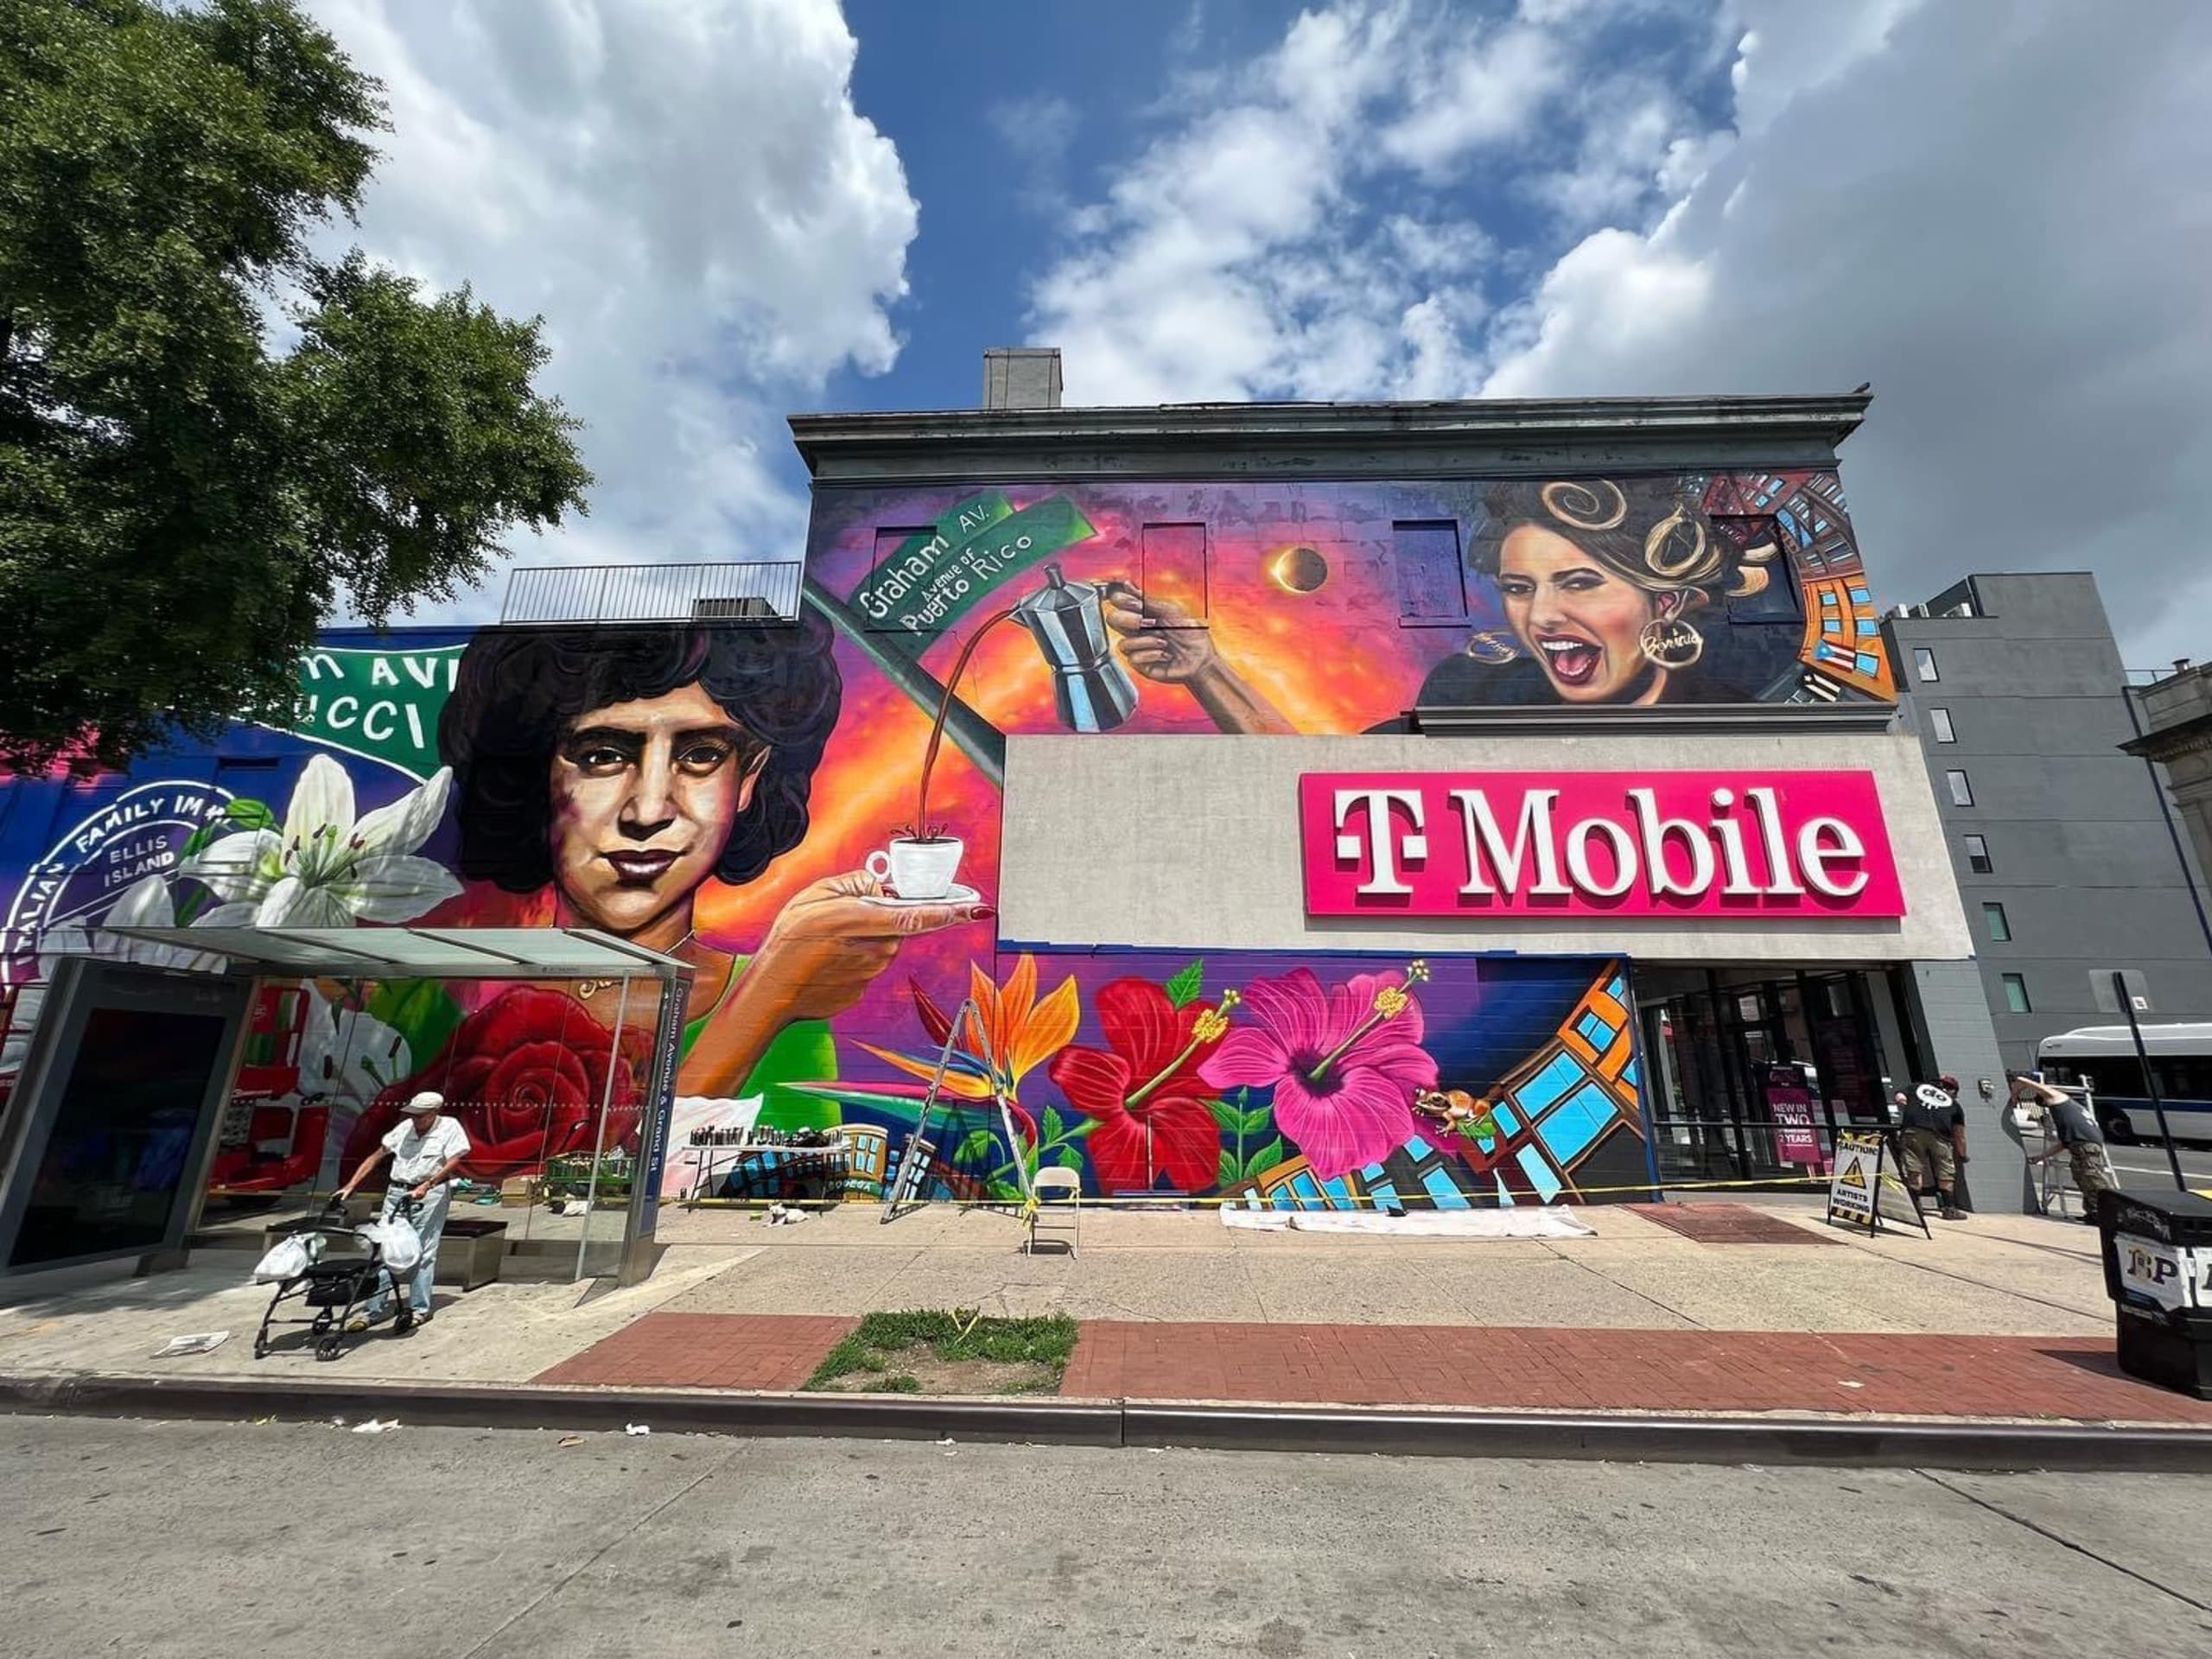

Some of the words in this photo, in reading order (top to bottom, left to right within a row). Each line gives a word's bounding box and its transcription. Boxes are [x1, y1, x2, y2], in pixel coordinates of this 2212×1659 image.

[860, 536, 949, 618] Graham
[899, 580, 969, 637] Puerto
[971, 536, 1032, 581] Rico
[921, 564, 963, 601] Avenue
[110, 836, 168, 864] ELLIS
[1449, 788, 1869, 897] Mobile
[14, 862, 64, 966] ITALIAN
[75, 798, 165, 853] FAMILY
[104, 851, 175, 887] ISLAND
[671, 987, 683, 1039] Graham
[662, 1043, 676, 1092] Avenue
[1773, 1103, 1795, 1113] NEW
[1797, 1103, 1808, 1113] IN
[1775, 1113, 1810, 1125] TWO
[653, 1109, 666, 1155] Grand
[1784, 1135, 1813, 1143] YEARS
[1833, 1198, 1870, 1213] WORKING
[1837, 1188, 1868, 1202] ARTISTS
